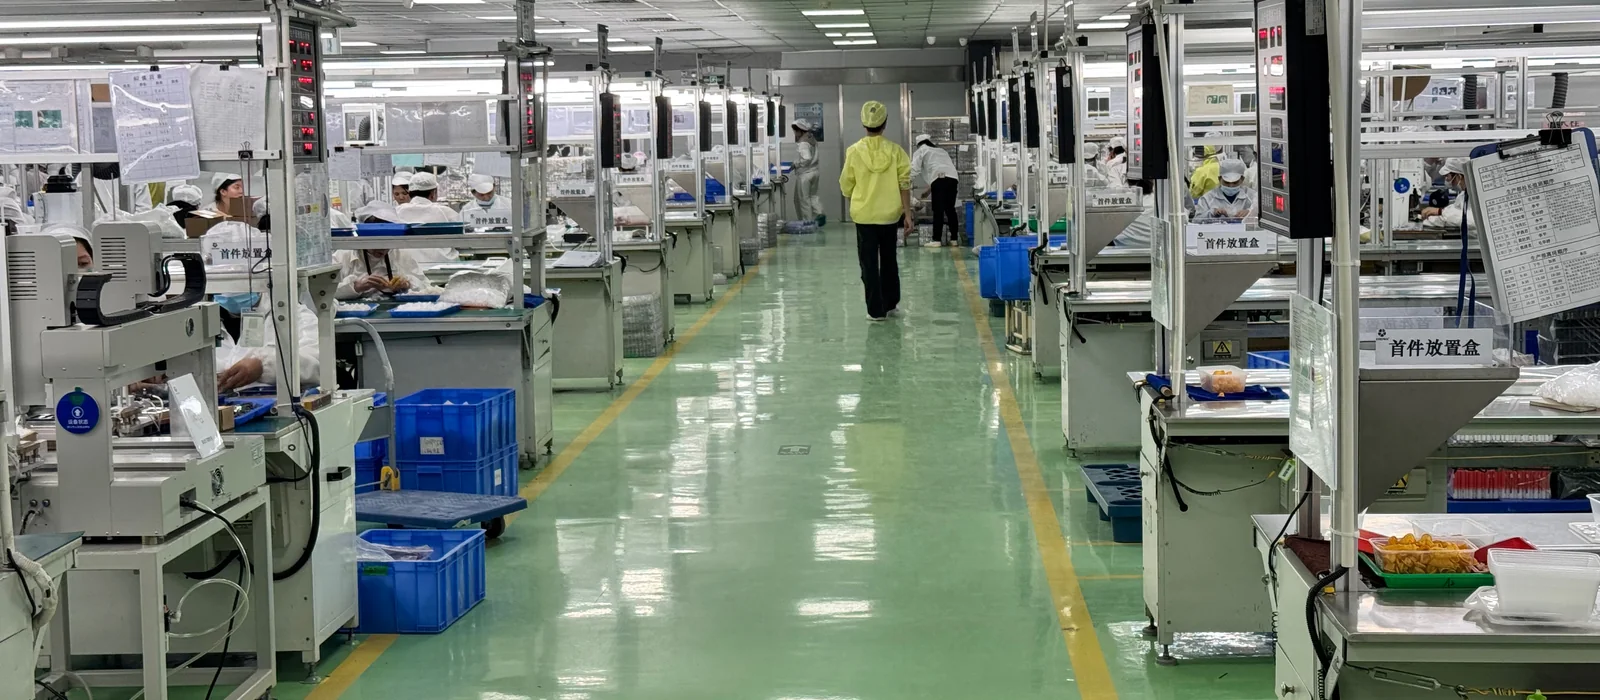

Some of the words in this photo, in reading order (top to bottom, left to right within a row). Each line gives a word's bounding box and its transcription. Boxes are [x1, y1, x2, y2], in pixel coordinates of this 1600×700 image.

[1097, 197, 1133, 206] 首件放置盒
[475, 217, 509, 225] 首件放置盒
[1205, 237, 1260, 249] 首件放置盒
[1389, 339, 1481, 358] 首件放置盒
